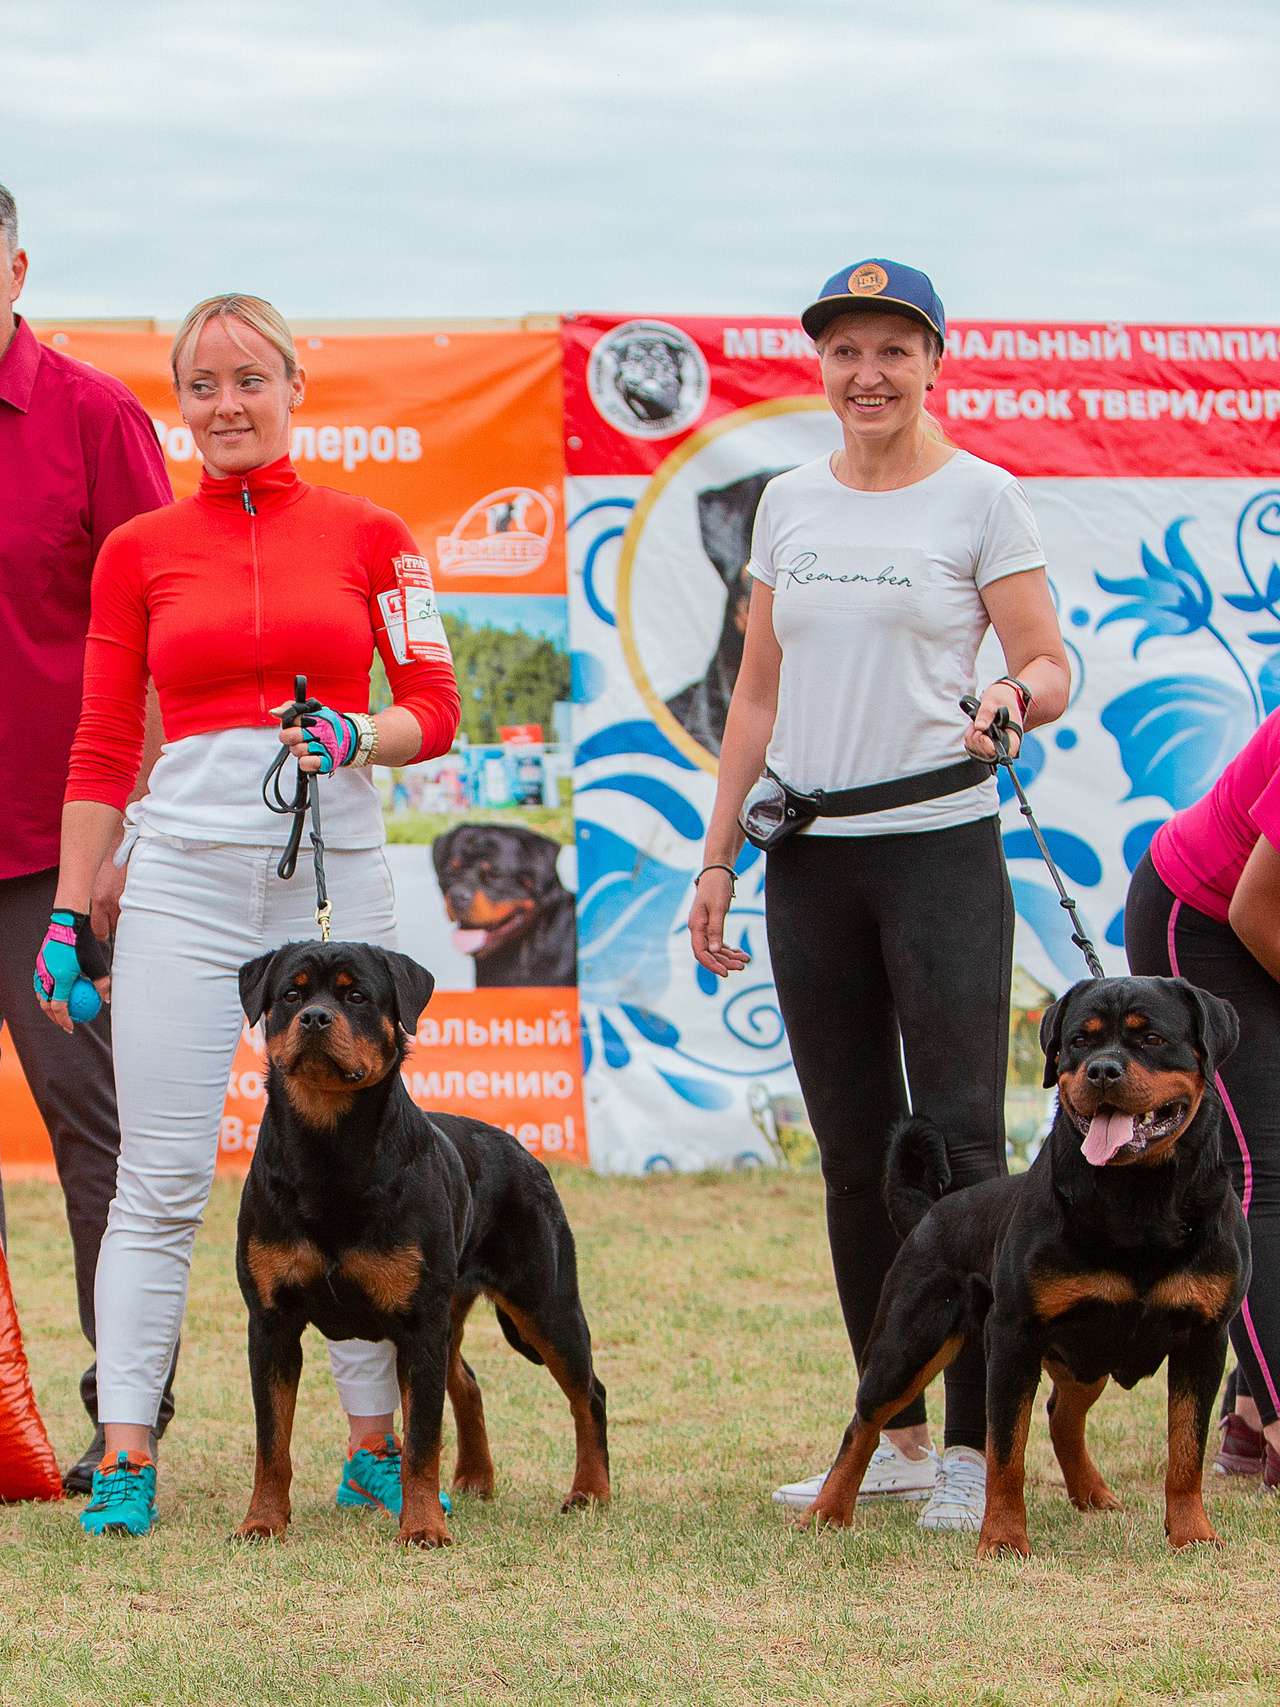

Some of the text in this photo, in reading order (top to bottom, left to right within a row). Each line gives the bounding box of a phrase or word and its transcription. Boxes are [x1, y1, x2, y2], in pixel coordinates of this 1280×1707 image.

[1140, 330, 1280, 361] ЧЕМПИ
[946, 388, 1073, 420] КУБОК
[786, 552, 912, 589] Remember
